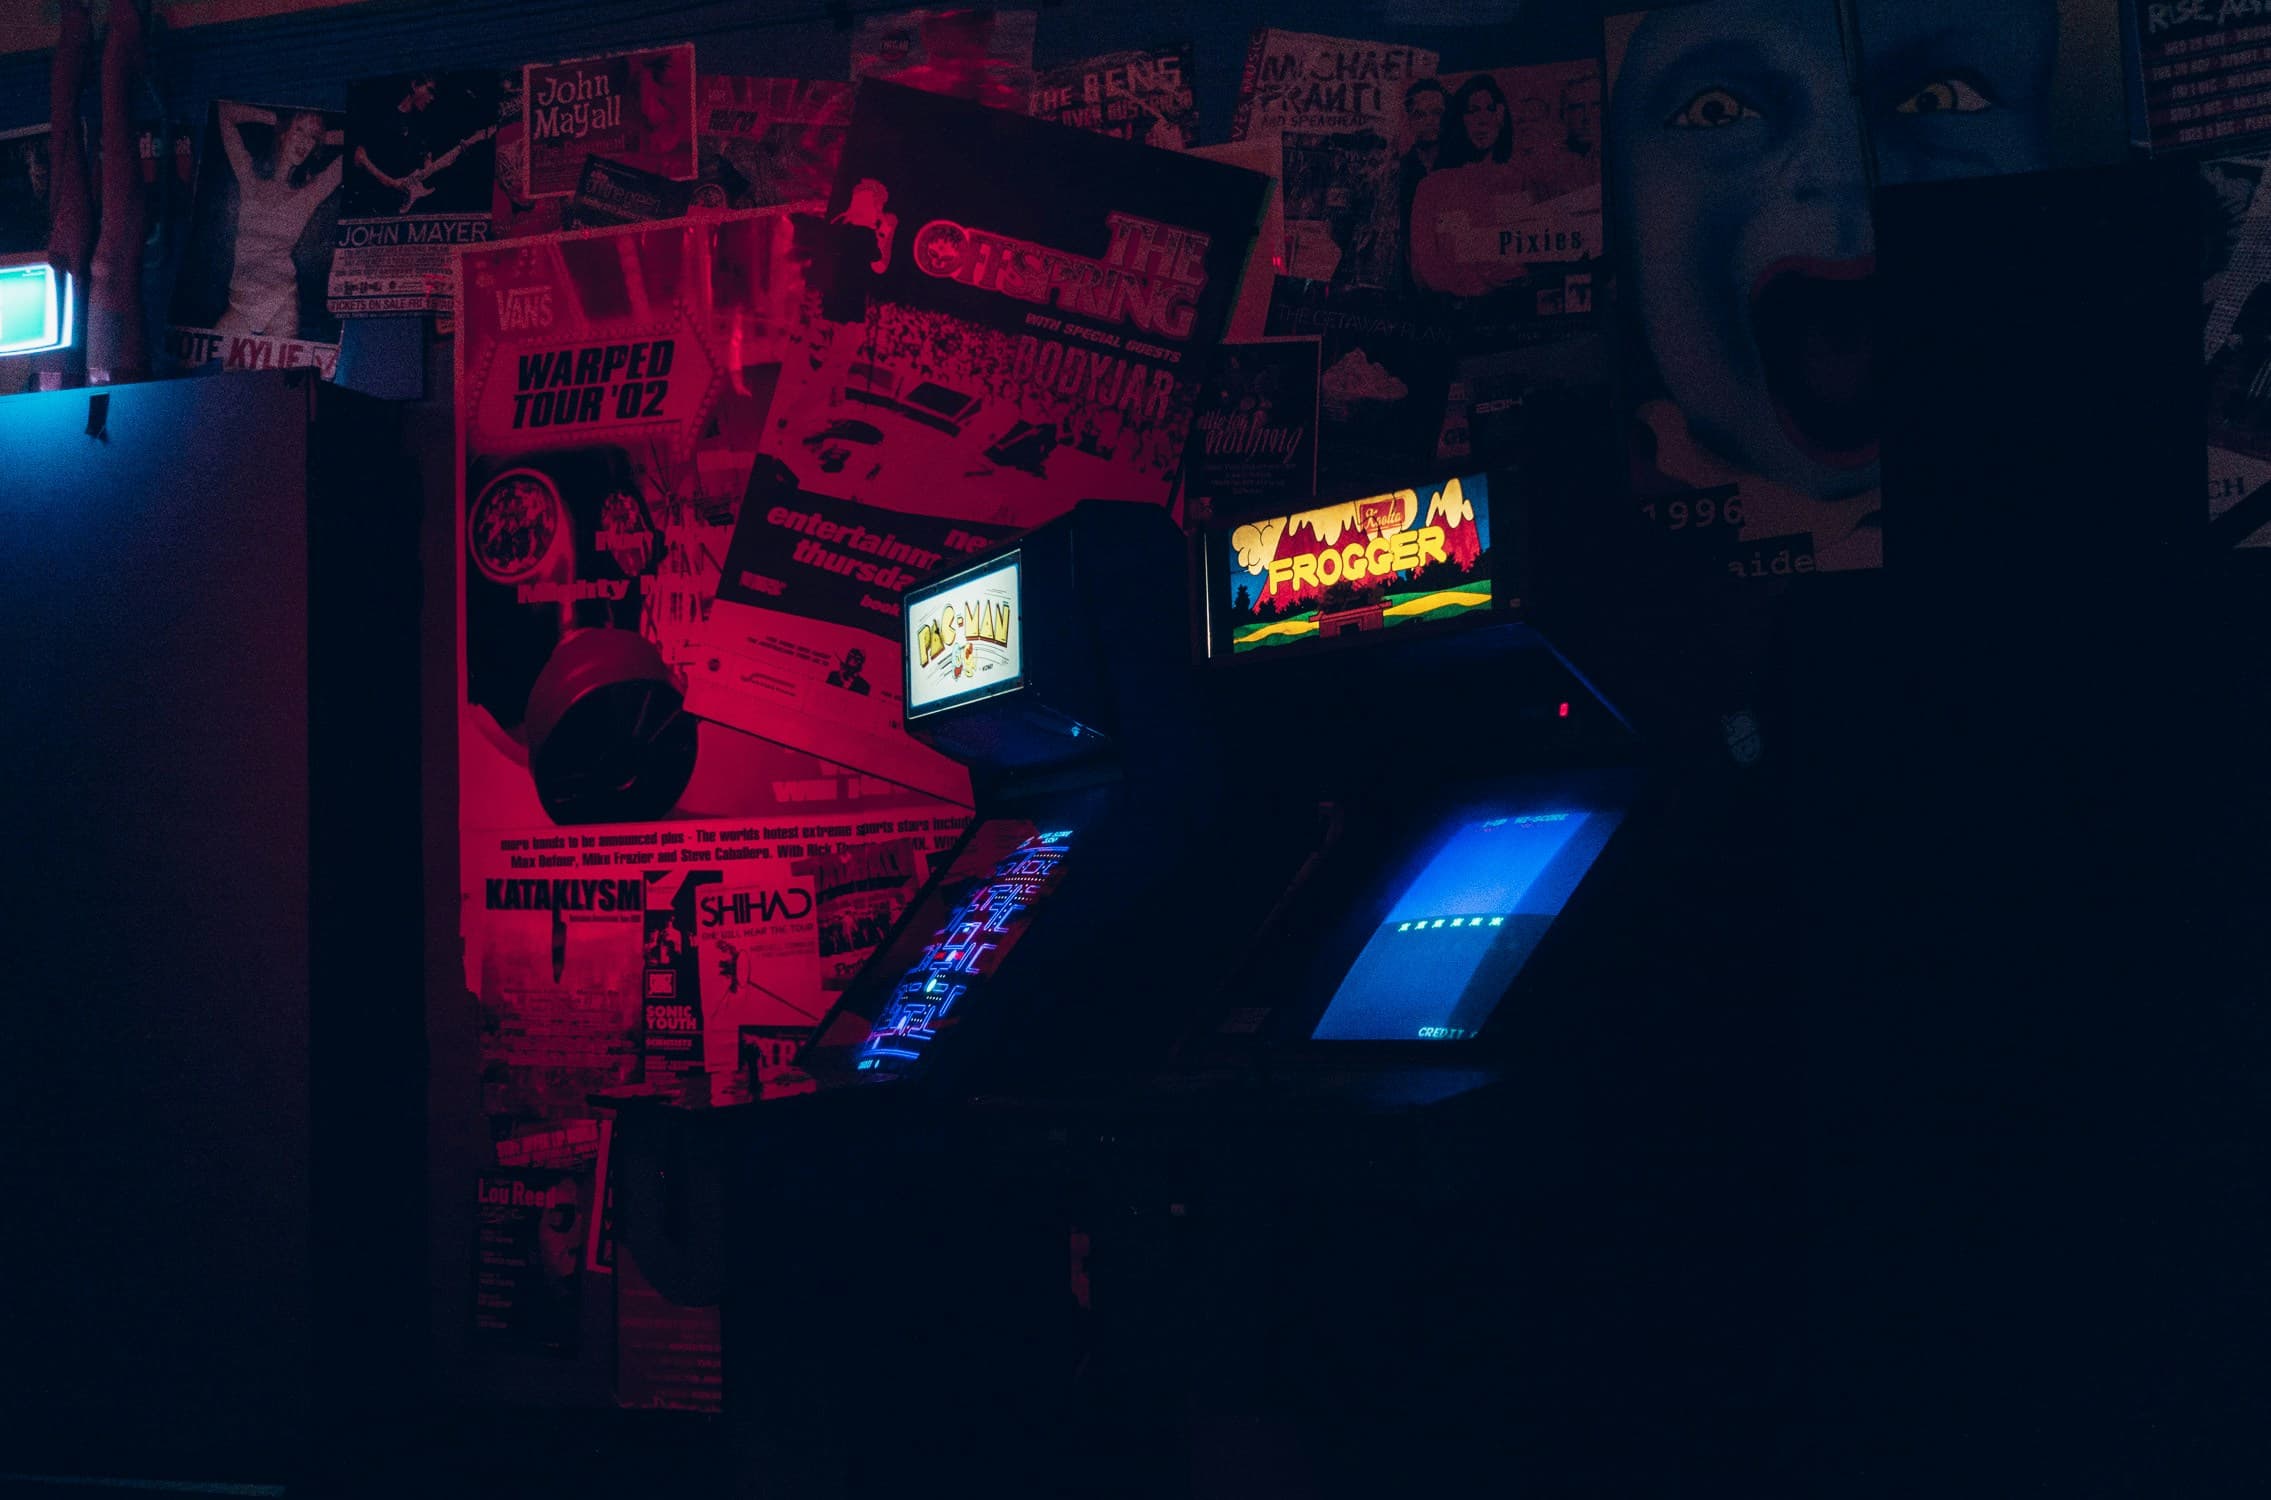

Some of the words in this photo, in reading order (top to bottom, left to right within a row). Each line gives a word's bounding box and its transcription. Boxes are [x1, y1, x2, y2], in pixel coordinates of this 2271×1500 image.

[537, 70, 610, 106] John
[1083, 56, 1181, 104] BENS
[533, 95, 621, 139] Mayall
[338, 224, 399, 247] JOHN
[407, 221, 488, 243] MAYER
[1106, 211, 1210, 285] THE
[1499, 228, 1583, 255] Pixies
[496, 285, 553, 331] VANS
[227, 338, 303, 370] KYLIE
[1063, 320, 1121, 349] SPECIAL
[1125, 338, 1183, 364] GUESTS
[517, 340, 676, 392] WARPED
[512, 387, 606, 430] TOUR
[611, 380, 669, 420] '02
[1641, 495, 1744, 531] 1996
[1268, 525, 1447, 595] FROGGER
[917, 600, 1010, 669] PAC-MAN
[501, 840, 529, 851] more
[533, 836, 565, 850] bands
[568, 837, 579, 849] to
[582, 835, 595, 848] be
[599, 831, 658, 847] announced
[661, 831, 684, 846] plus
[696, 829, 716, 843] The
[803, 822, 852, 838] extreme
[855, 820, 894, 837] sports
[897, 819, 929, 833] stars
[511, 855, 535, 869] Max
[582, 852, 610, 866] Mike
[614, 851, 655, 865] Frazier
[658, 849, 677, 863] and
[681, 847, 711, 862] Steve
[777, 844, 804, 859] With
[807, 842, 832, 857] Rick
[485, 878, 641, 912] KATAKLYSM
[700, 887, 813, 927] SHIHAD
[646, 1005, 693, 1018] SONIC
[646, 1017, 697, 1030] YOUTH
[1418, 1026, 1465, 1040] CREDIT
[477, 1177, 510, 1204] Lou
